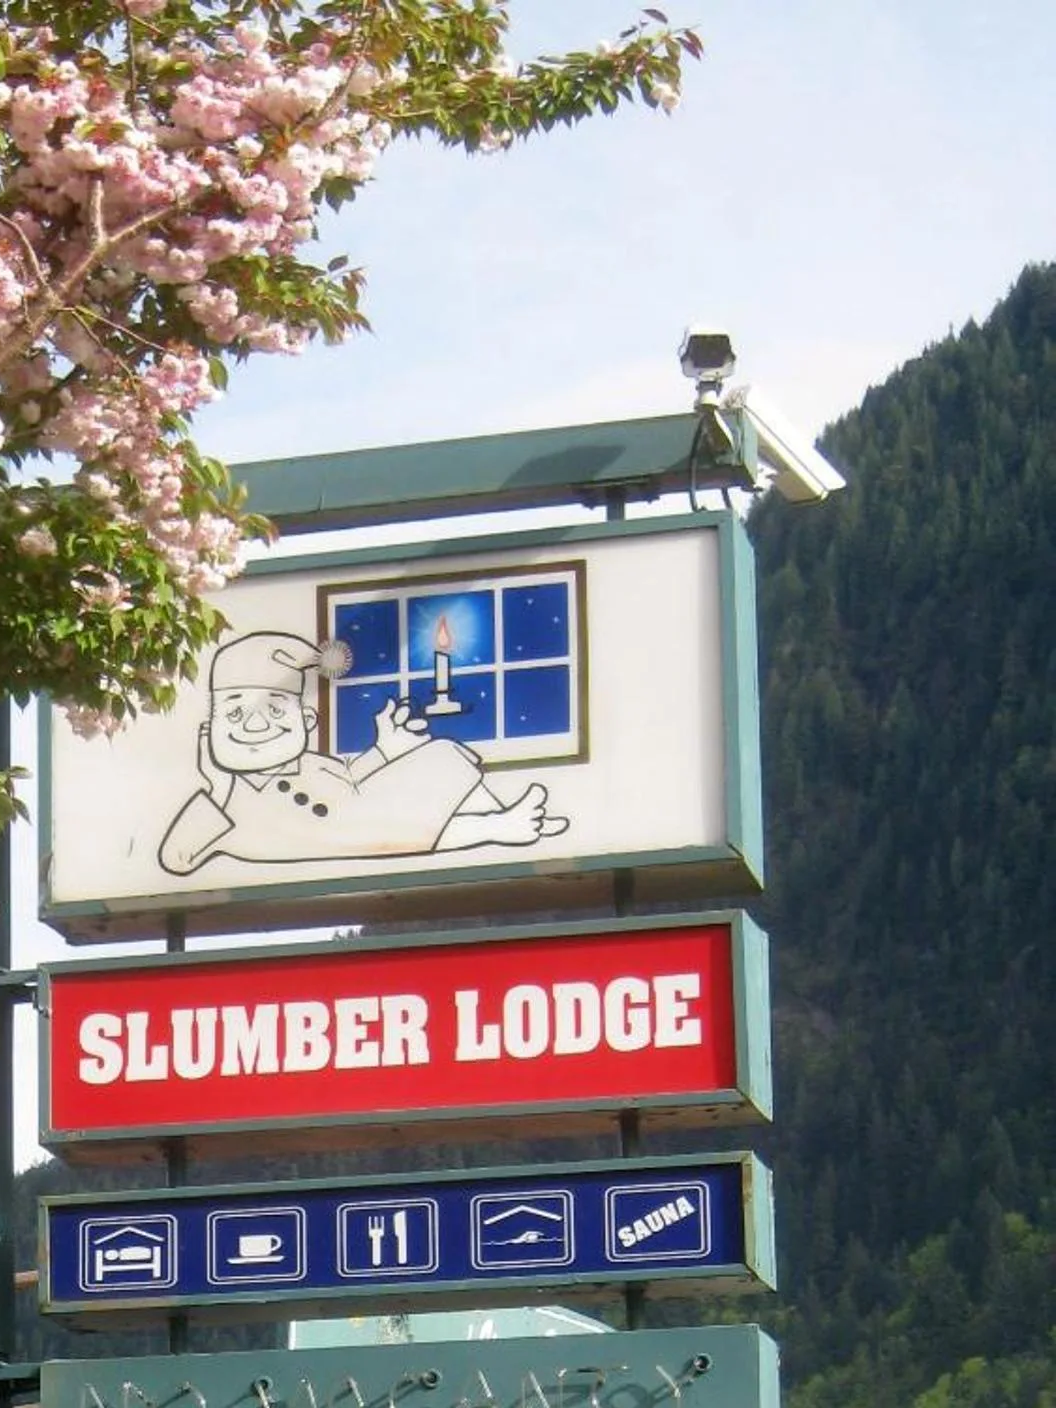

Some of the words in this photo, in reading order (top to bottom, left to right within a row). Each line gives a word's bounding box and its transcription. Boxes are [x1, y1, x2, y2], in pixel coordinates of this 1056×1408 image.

[78, 994, 430, 1086] SLUMBER
[455, 973, 702, 1062] LODGE
[617, 1196, 696, 1248] SAUNA
